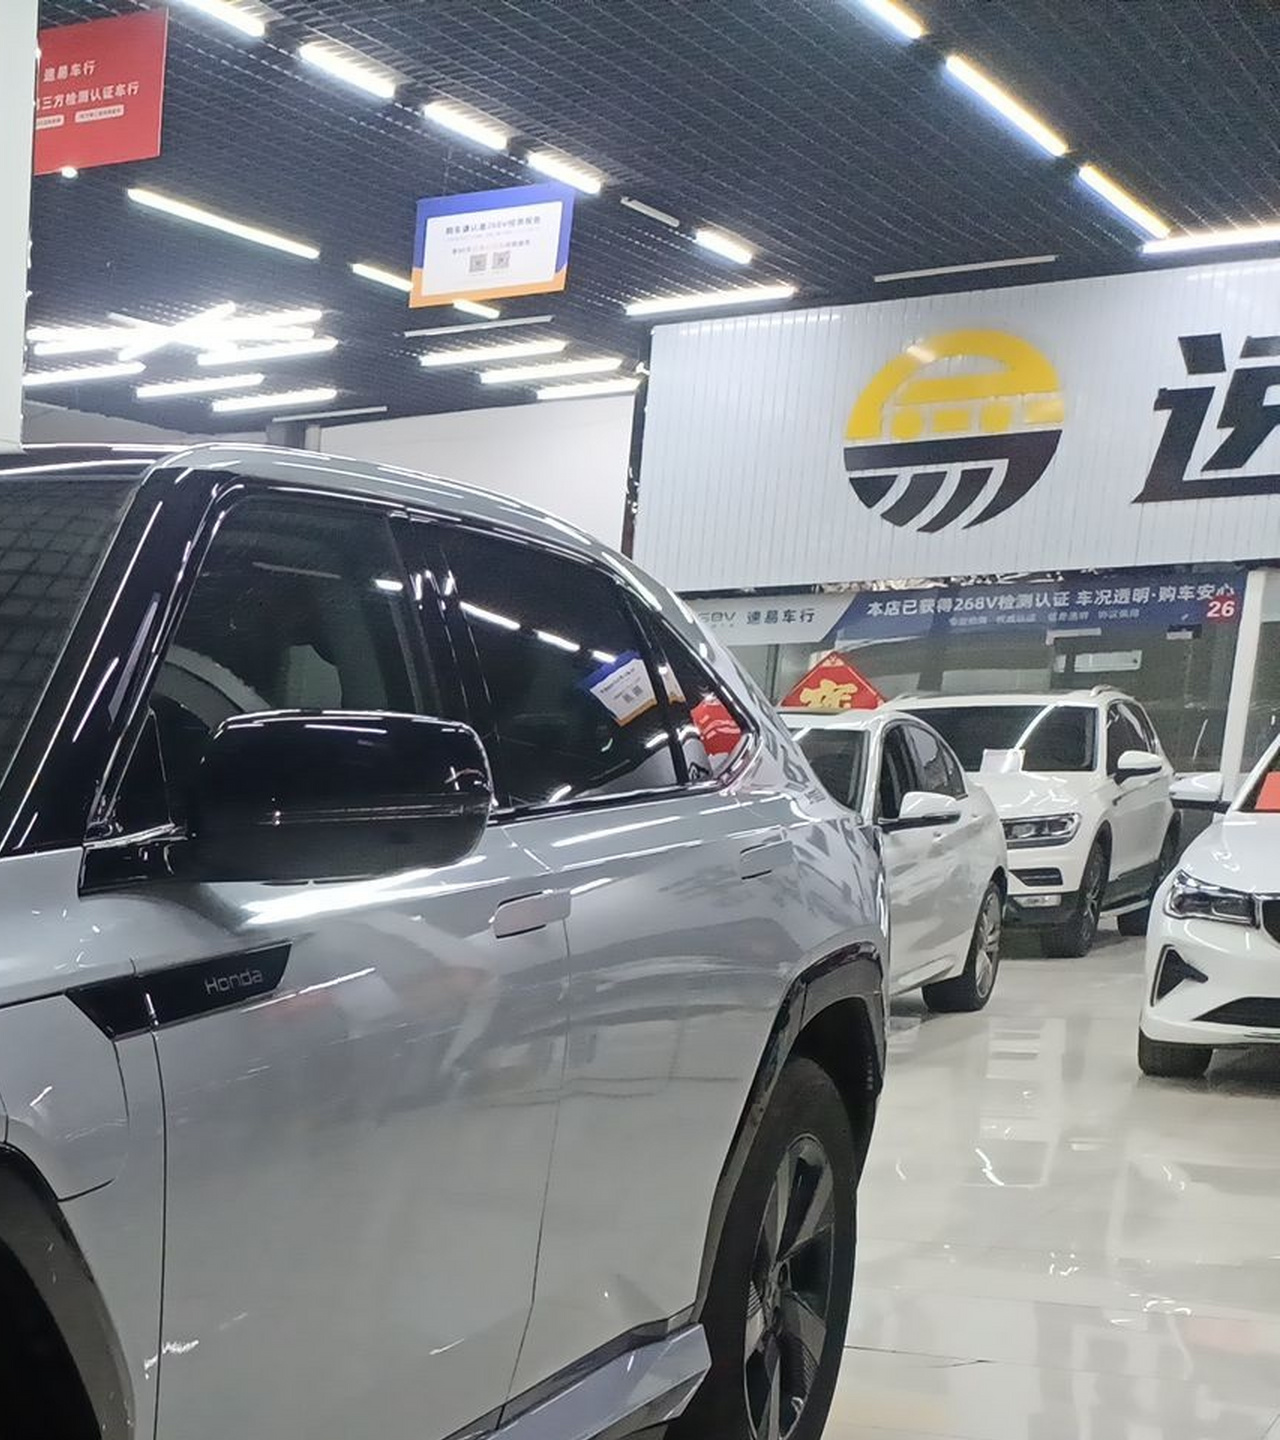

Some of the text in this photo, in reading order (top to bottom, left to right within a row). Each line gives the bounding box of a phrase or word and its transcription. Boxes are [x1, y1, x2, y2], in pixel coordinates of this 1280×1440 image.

[37, 81, 140, 111] 三方检测认证车行
[746, 607, 817, 625] 速易车行
[867, 591, 1071, 617] 本店已获得268V检测认证
[204, 967, 265, 995] Honda
